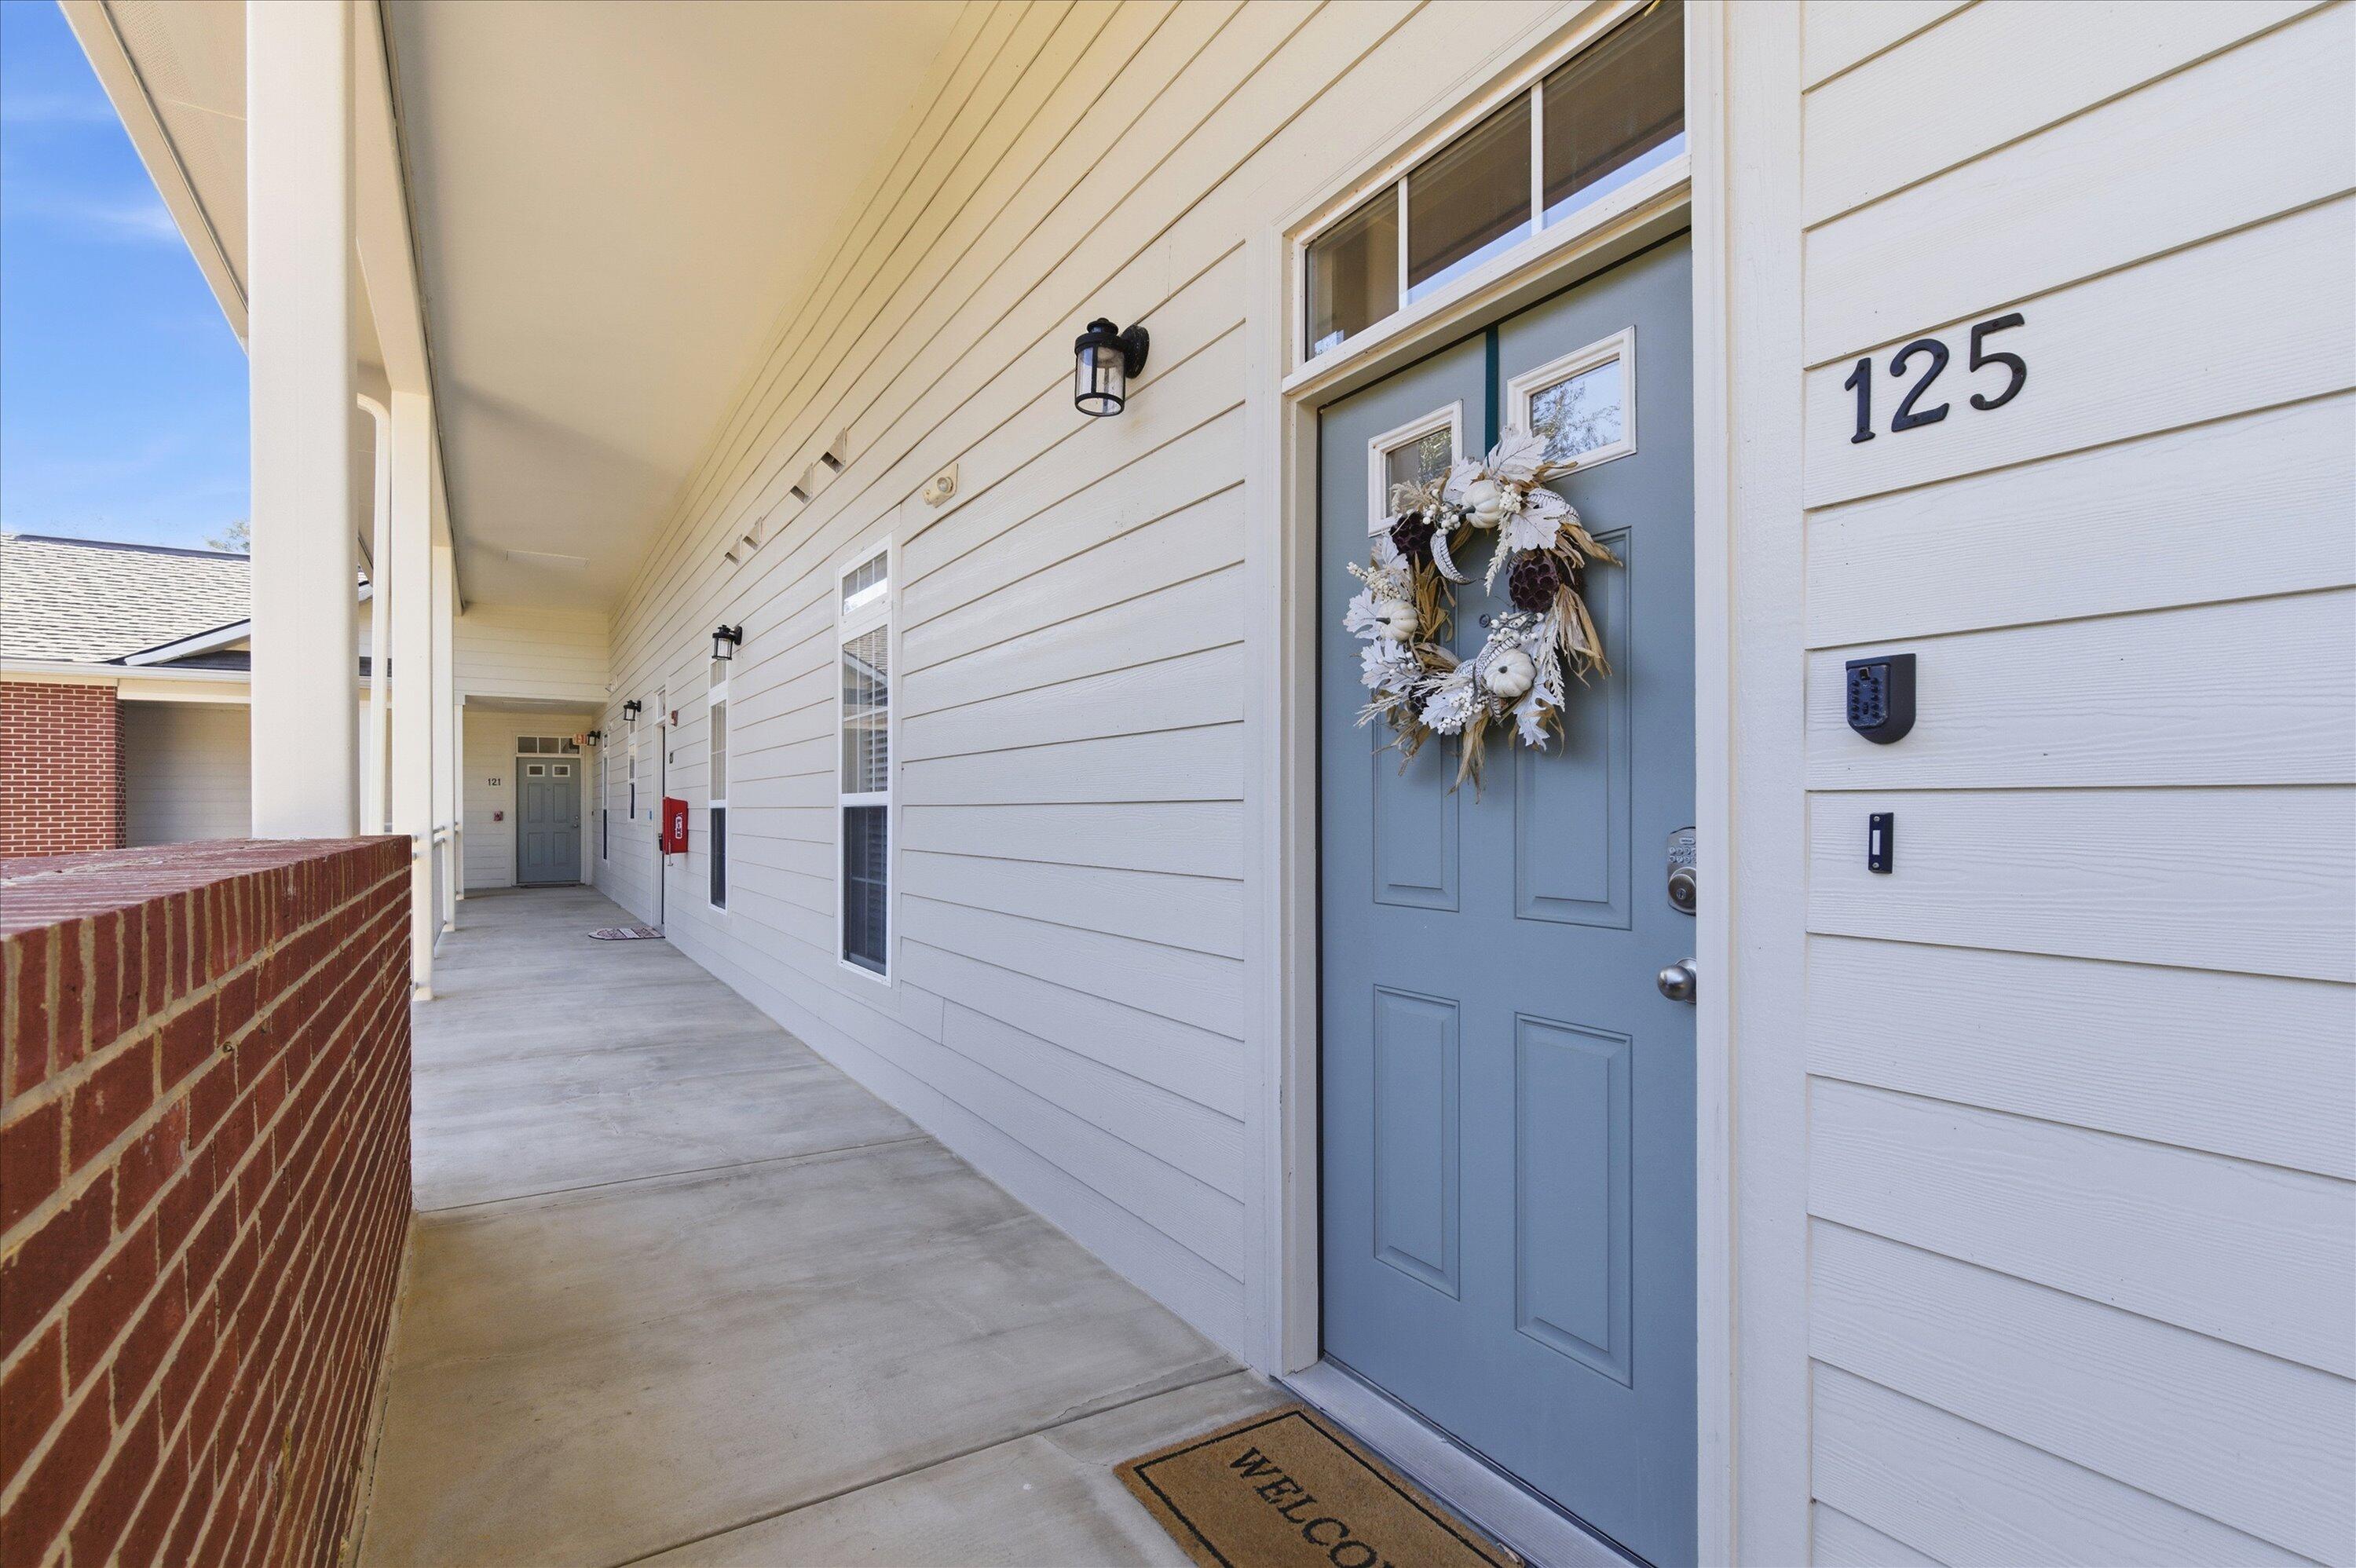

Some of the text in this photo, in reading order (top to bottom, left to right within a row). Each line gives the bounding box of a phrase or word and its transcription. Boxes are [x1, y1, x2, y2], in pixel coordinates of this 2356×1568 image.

[1845, 313, 2027, 444] 125
[488, 777, 501, 786] 121
[1228, 1447, 1395, 1568] WELCO
